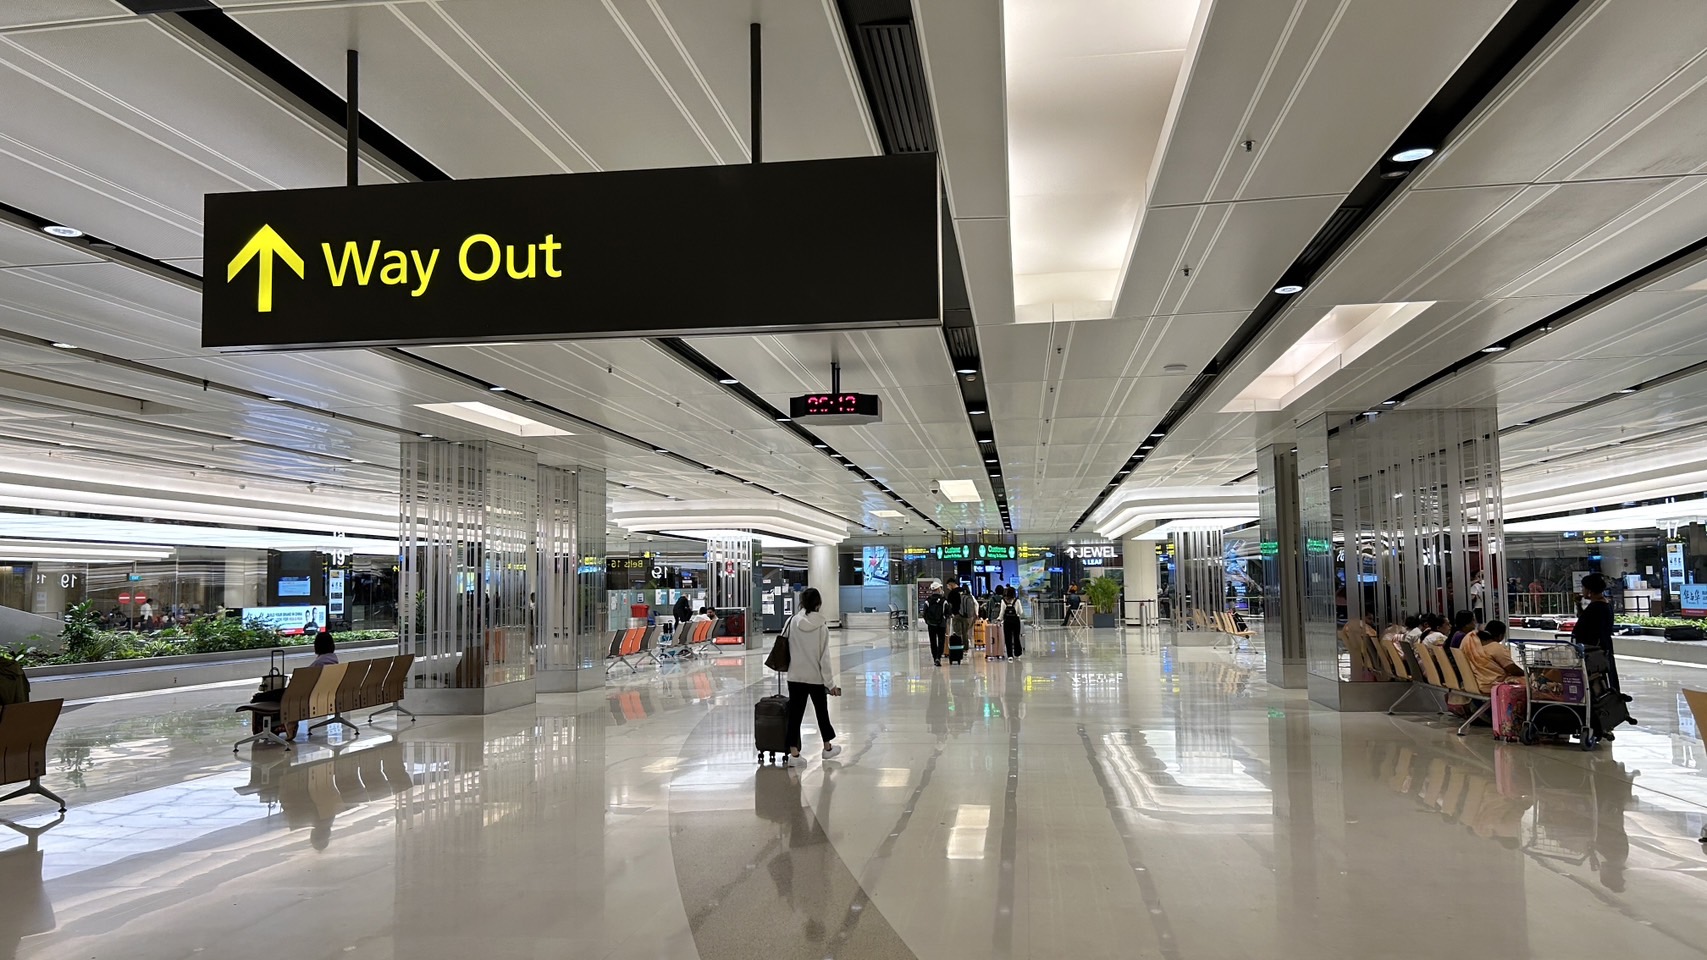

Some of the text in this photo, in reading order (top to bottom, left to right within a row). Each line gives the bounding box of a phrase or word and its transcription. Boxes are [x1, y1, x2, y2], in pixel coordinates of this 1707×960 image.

[321, 233, 562, 297] Way Out
[332, 549, 345, 566] 19
[1077, 546, 1118, 558] JEWEL
